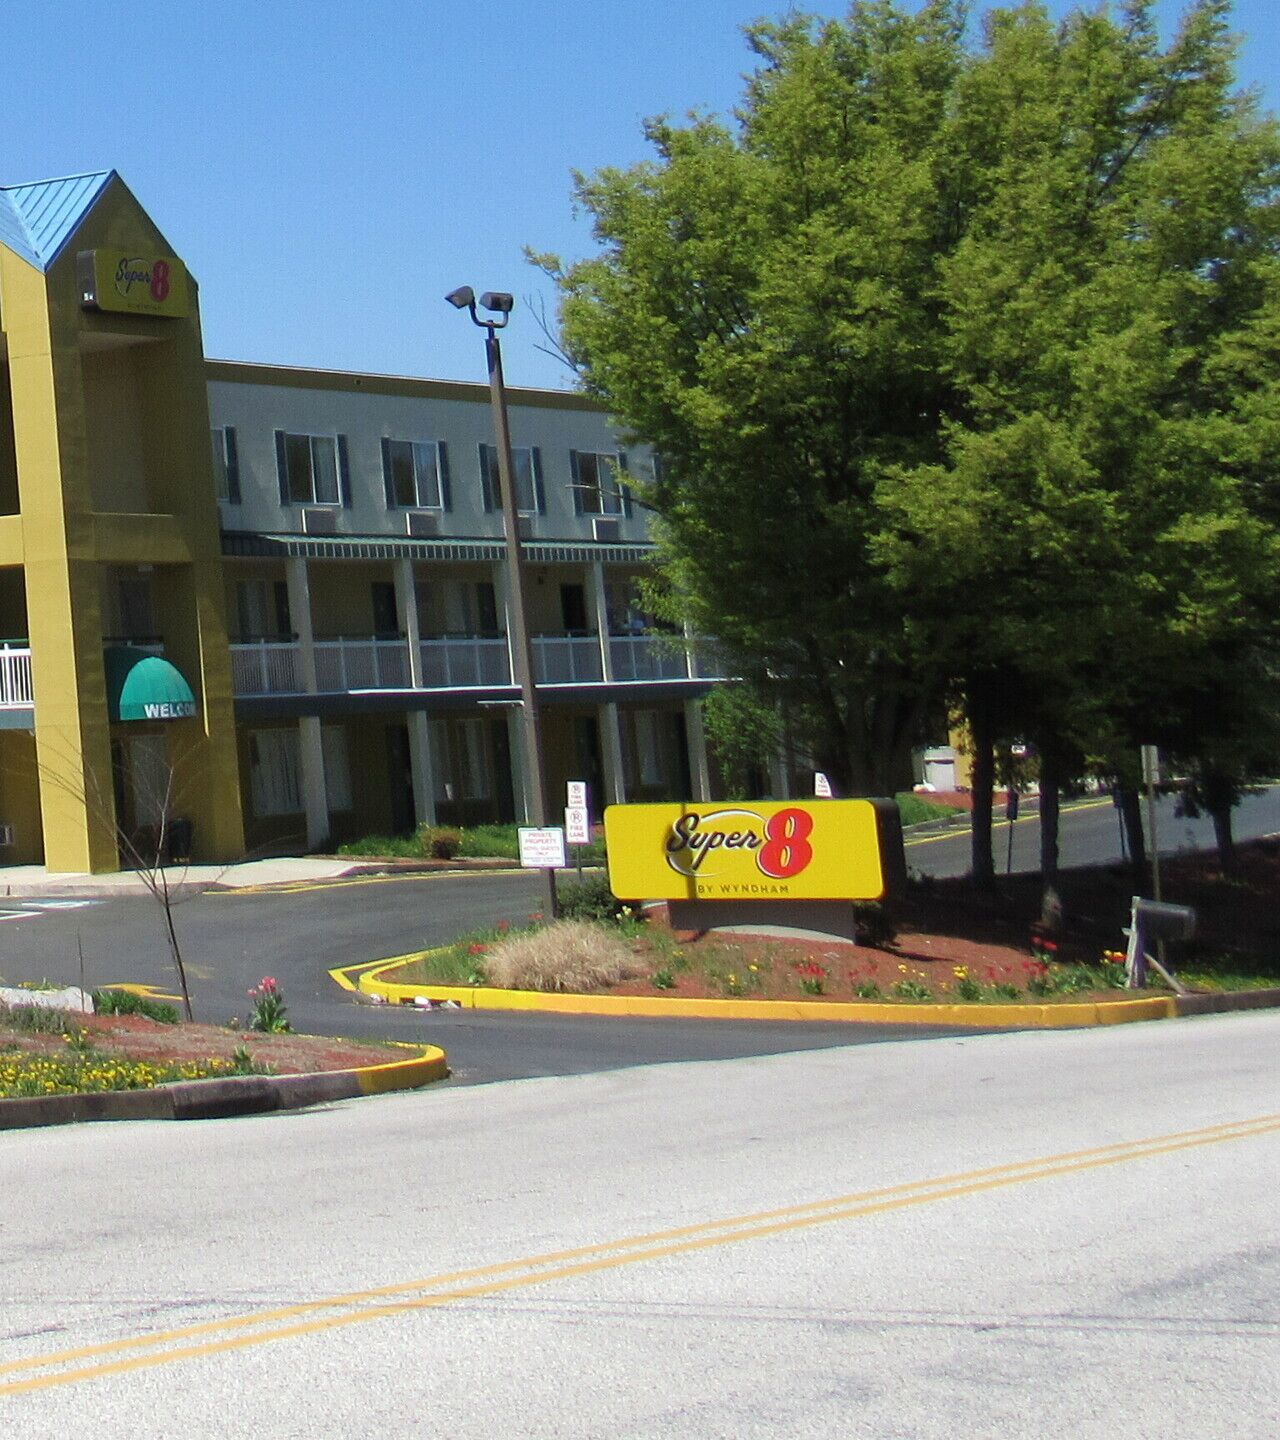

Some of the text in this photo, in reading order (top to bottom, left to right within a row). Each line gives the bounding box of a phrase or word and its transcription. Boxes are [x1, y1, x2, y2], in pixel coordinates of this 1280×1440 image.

[115, 257, 170, 301] Super 8
[666, 808, 814, 878] Super 8
[698, 884, 789, 894] BY WYNDHAM
